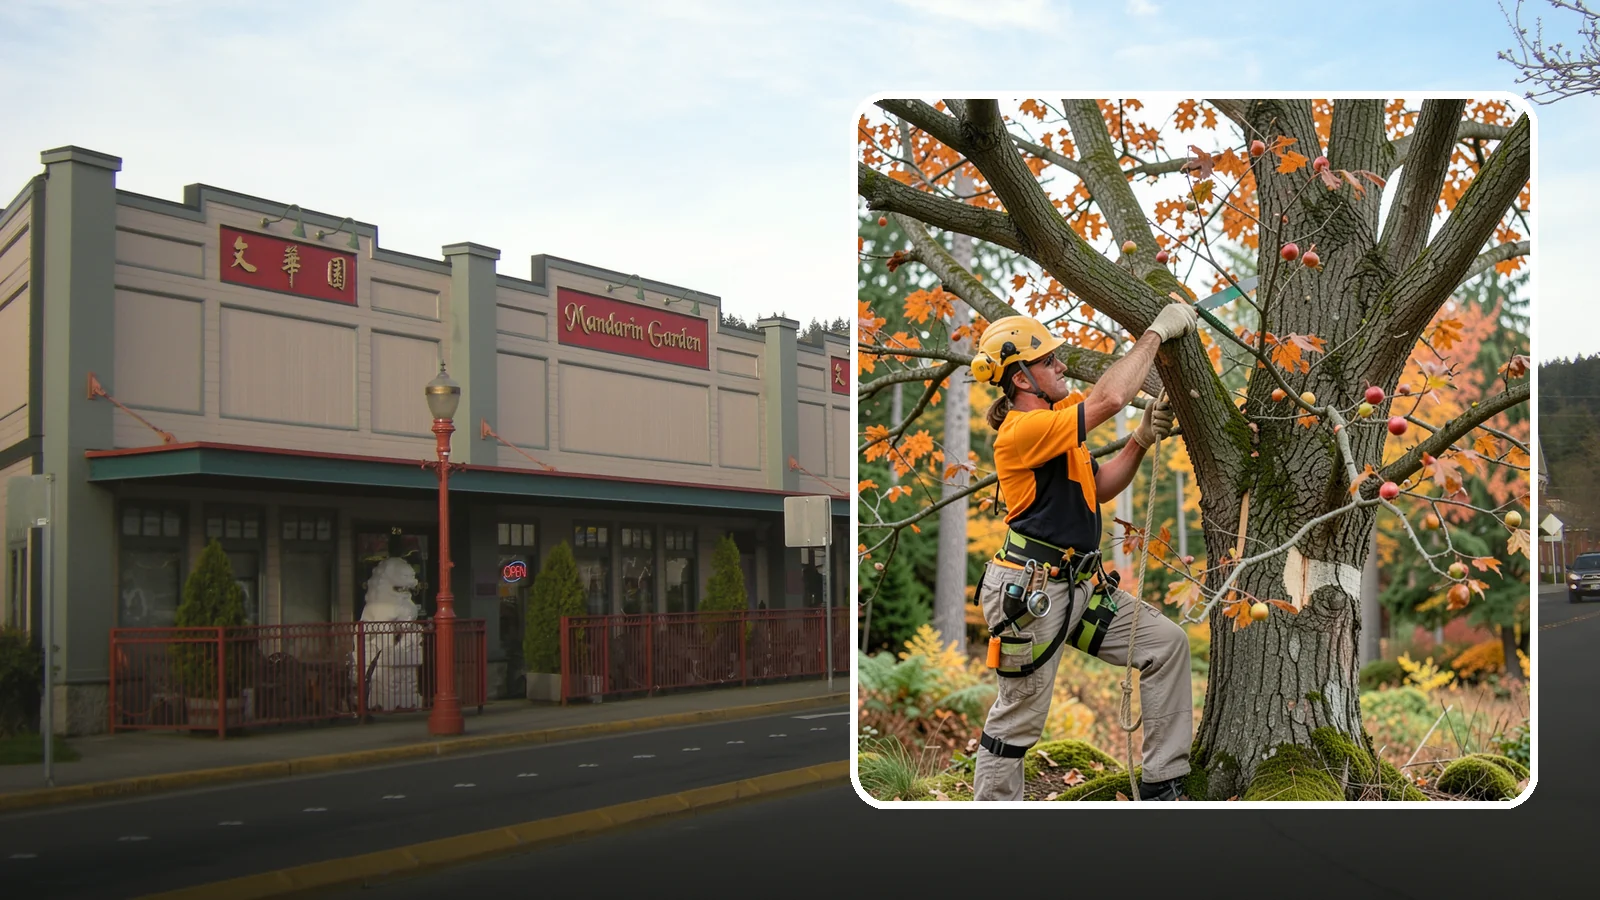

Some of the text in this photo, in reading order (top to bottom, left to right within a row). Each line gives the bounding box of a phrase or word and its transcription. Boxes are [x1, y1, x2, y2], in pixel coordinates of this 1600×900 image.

[564, 302, 701, 352] Mandarin Garden
[503, 565, 527, 578] OPEN
